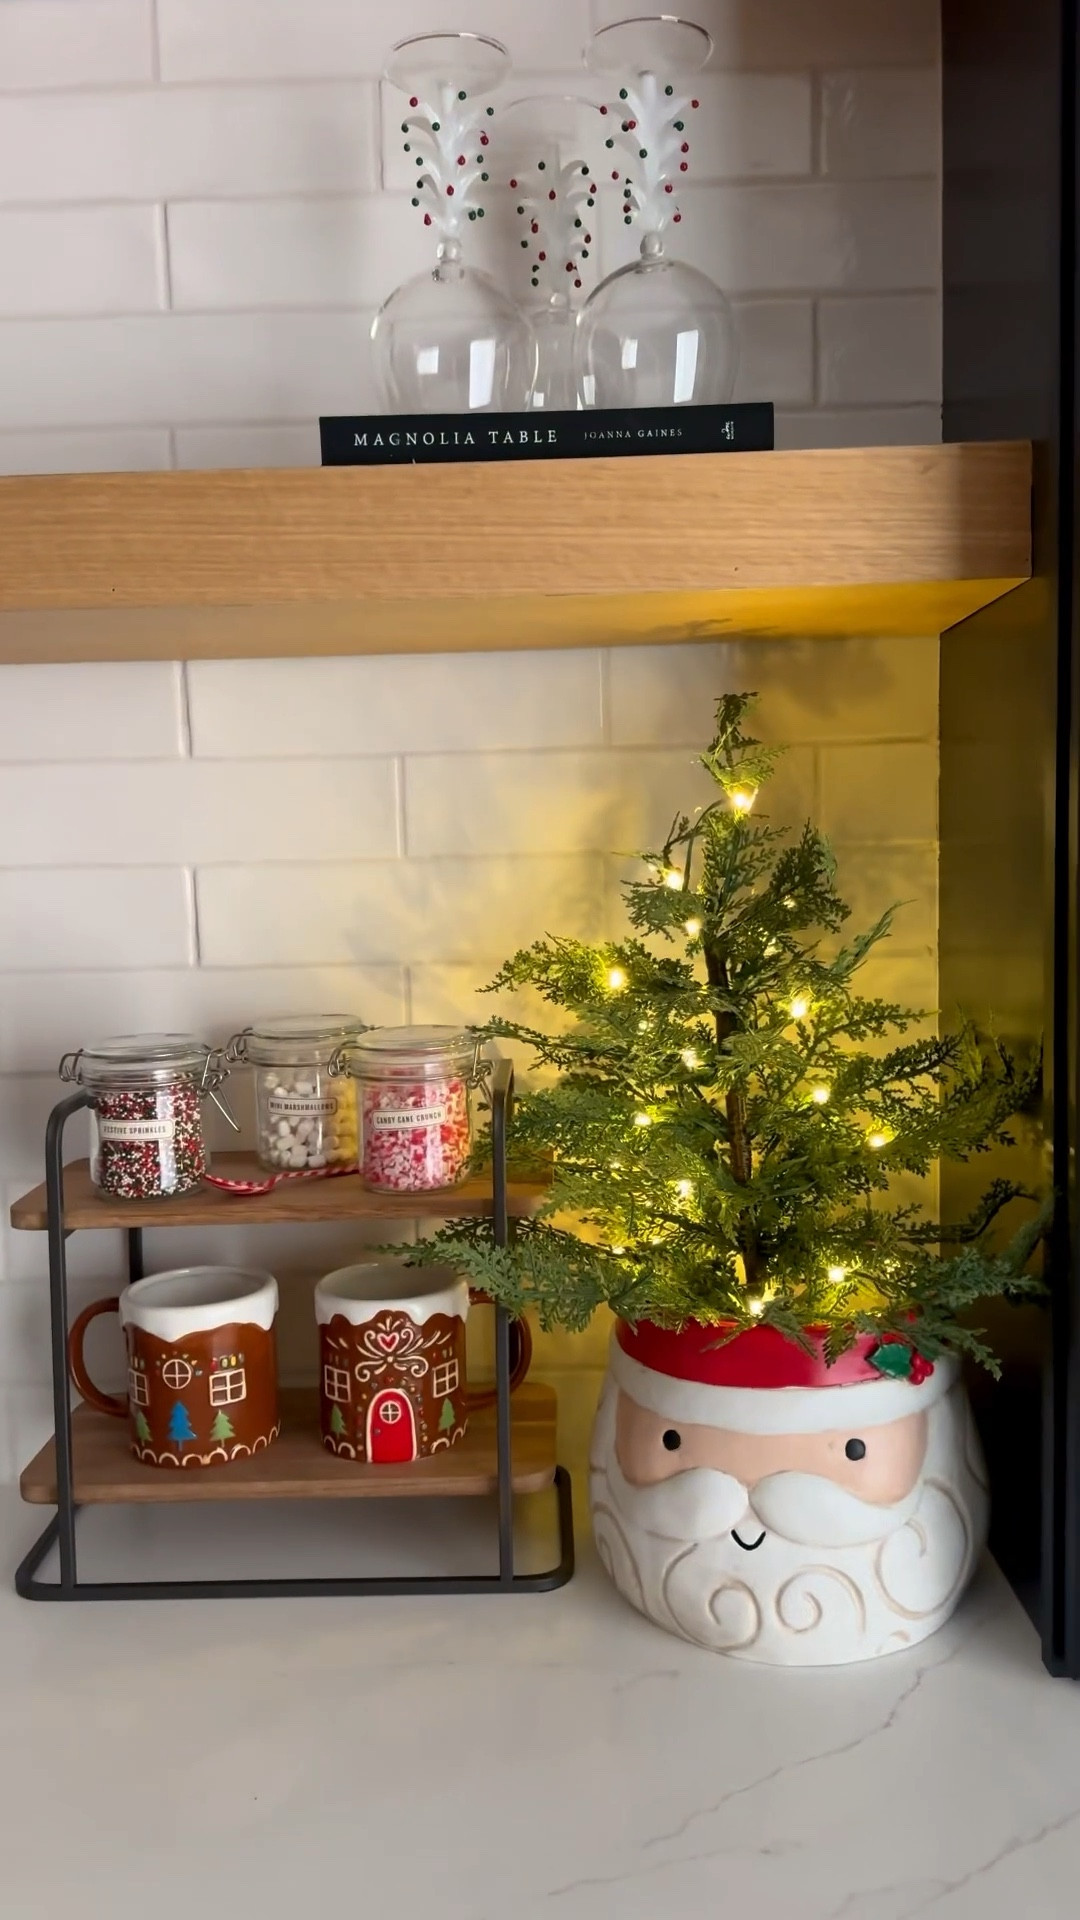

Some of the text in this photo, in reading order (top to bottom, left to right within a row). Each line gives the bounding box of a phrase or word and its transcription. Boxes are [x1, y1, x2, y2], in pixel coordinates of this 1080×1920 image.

[353, 429, 558, 446] MAGNOLIA TABLE
[584, 428, 683, 440] JOANNA GAINES
[284, 1102, 334, 1111] MARSHMALLOWS
[376, 1111, 442, 1125] CANDY CANE CRUNCH
[129, 1125, 166, 1134] SPRINKLES
